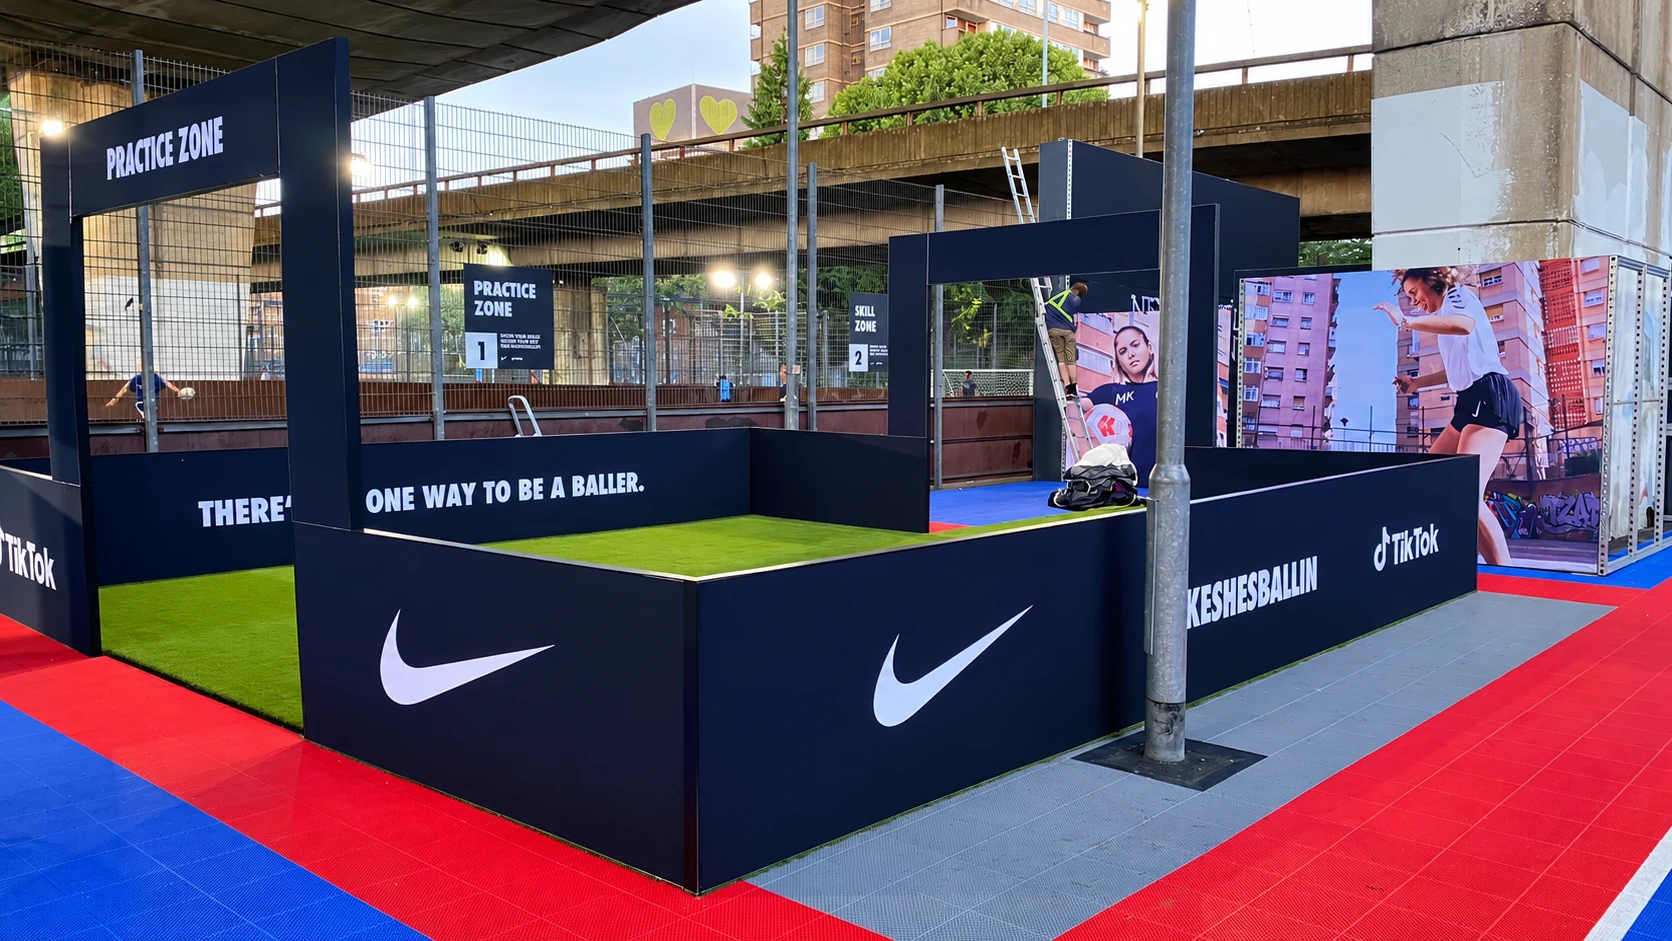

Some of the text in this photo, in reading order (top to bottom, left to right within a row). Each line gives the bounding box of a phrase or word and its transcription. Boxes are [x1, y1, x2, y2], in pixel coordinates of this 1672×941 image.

[107, 116, 224, 180] PRACTICE ZONE
[473, 280, 537, 299] PRACTICE
[474, 300, 513, 318] ZONE
[854, 305, 876, 317] SKILL
[854, 320, 877, 333] ZONE
[477, 341, 486, 361] 1
[854, 350, 862, 366] 2
[1115, 391, 1135, 405] MK
[365, 486, 415, 514] ONE
[422, 482, 477, 509] WAY
[483, 480, 511, 504] TO
[518, 478, 544, 502] BE
[550, 476, 566, 499] A
[571, 472, 645, 498] BALLER.
[1392, 523, 1440, 565] TikTok
[4, 532, 57, 591] TikTok
